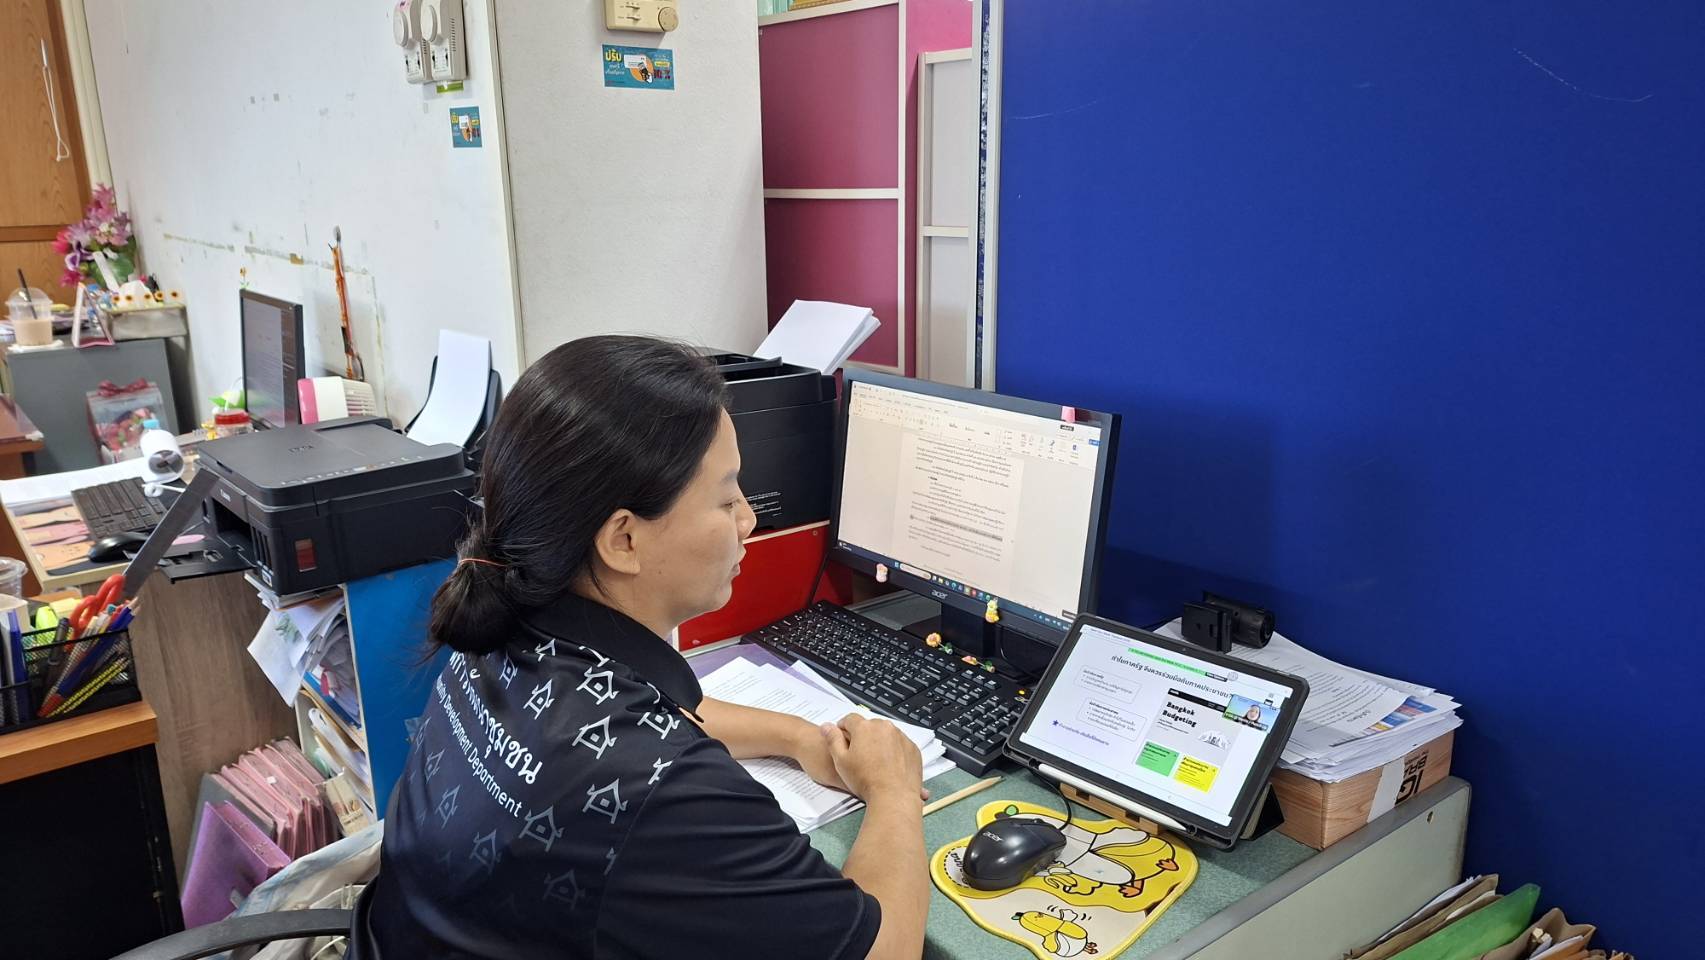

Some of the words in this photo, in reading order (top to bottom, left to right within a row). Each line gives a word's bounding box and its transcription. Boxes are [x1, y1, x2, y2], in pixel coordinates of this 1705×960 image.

[931, 589, 948, 600] acer
[1166, 701, 1195, 717] Bangkok
[1162, 709, 1197, 728] Budgeting
[443, 693, 473, 755] Development
[467, 747, 522, 818] Department
[983, 831, 1004, 842] acer
